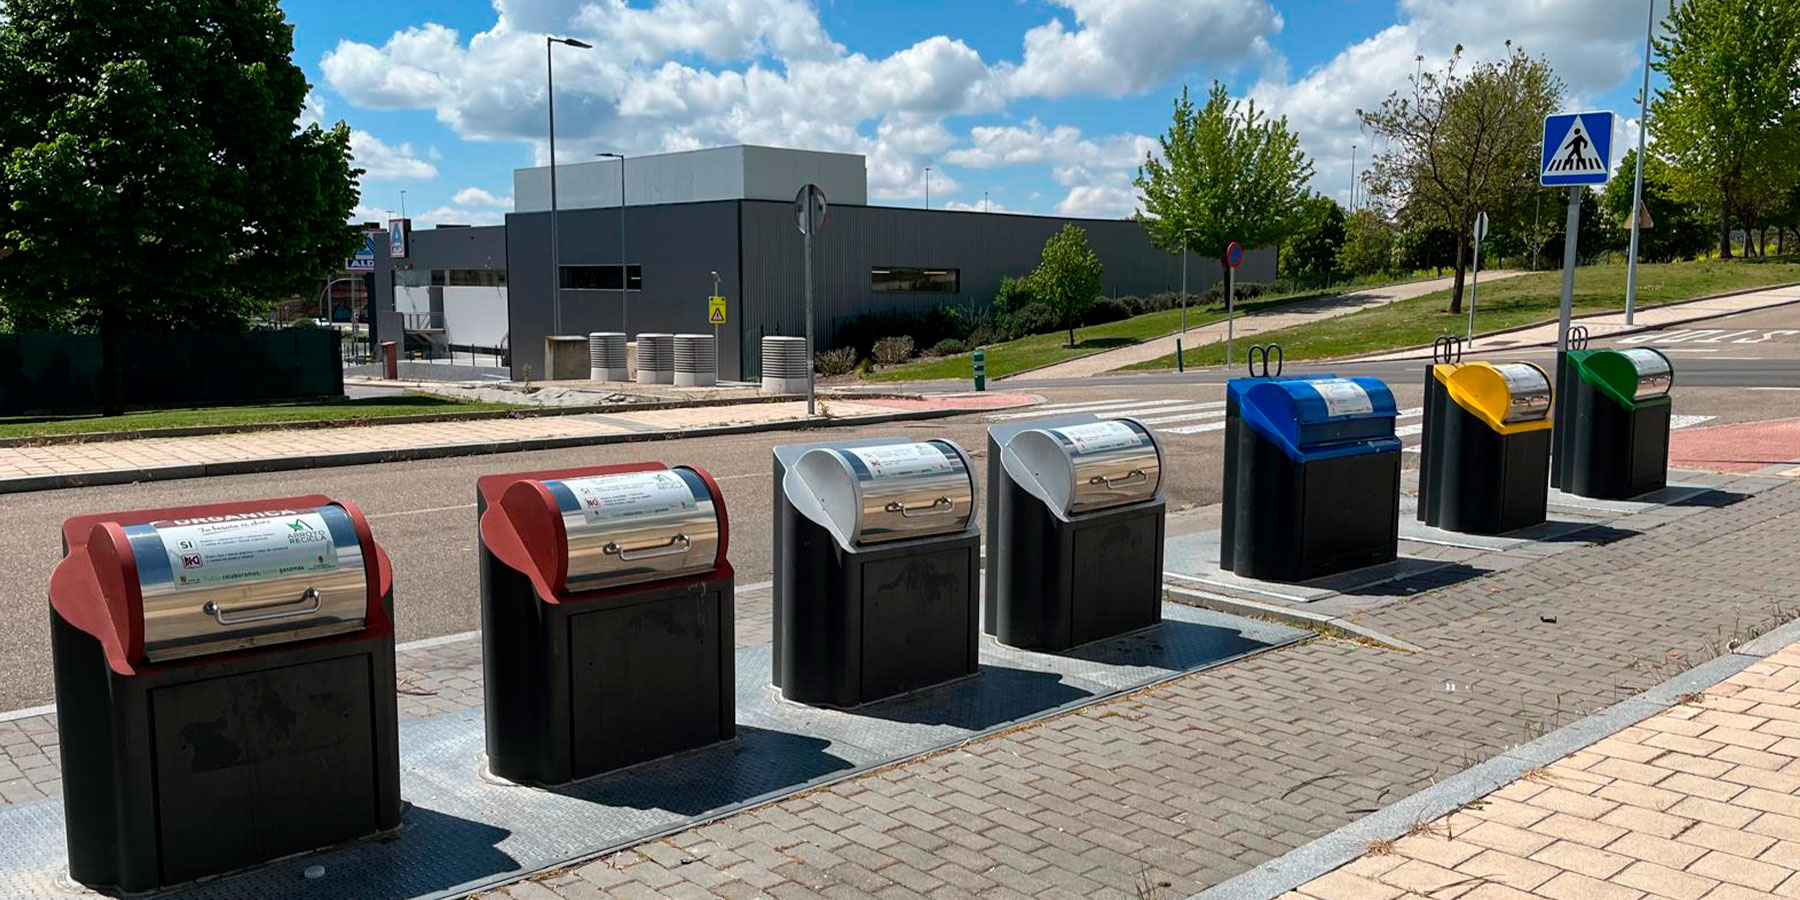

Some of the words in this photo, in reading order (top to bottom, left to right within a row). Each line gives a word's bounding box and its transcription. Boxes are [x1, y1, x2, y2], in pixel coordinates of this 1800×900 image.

[1616, 329, 1800, 344] STOP
[287, 529, 325, 540] ARROYO
[180, 541, 193, 549] SI
[289, 535, 327, 545] RECICLA
